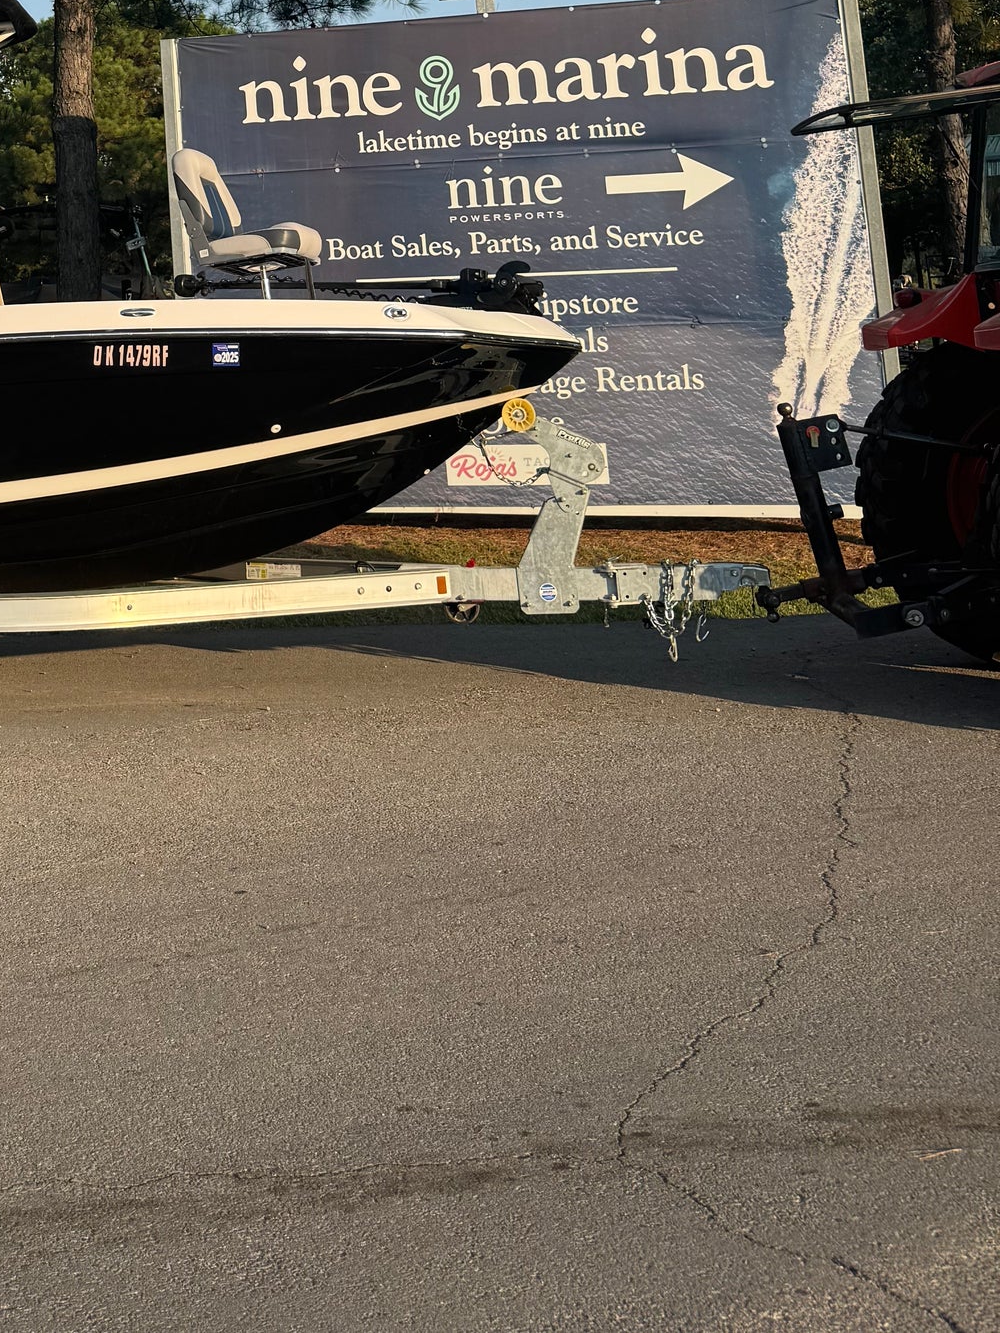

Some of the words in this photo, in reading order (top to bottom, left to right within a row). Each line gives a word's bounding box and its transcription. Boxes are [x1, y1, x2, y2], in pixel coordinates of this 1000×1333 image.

[238, 55, 403, 124] nine
[472, 27, 775, 108] marina
[357, 129, 461, 154] laketime
[467, 123, 548, 150] begins
[555, 123, 581, 141] at
[587, 116, 646, 140] nine
[445, 165, 563, 210] nine
[450, 210, 565, 223] POWERSPORTS
[326, 238, 384, 261] Boat
[391, 233, 461, 258] Sales,
[468, 231, 541, 255] Parts,
[550, 225, 599, 251] and
[606, 223, 705, 249] Service
[534, 291, 639, 322] ipstore
[221, 351, 239, 363] 2025
[533, 376, 587, 399] age
[594, 363, 705, 392] Rentals
